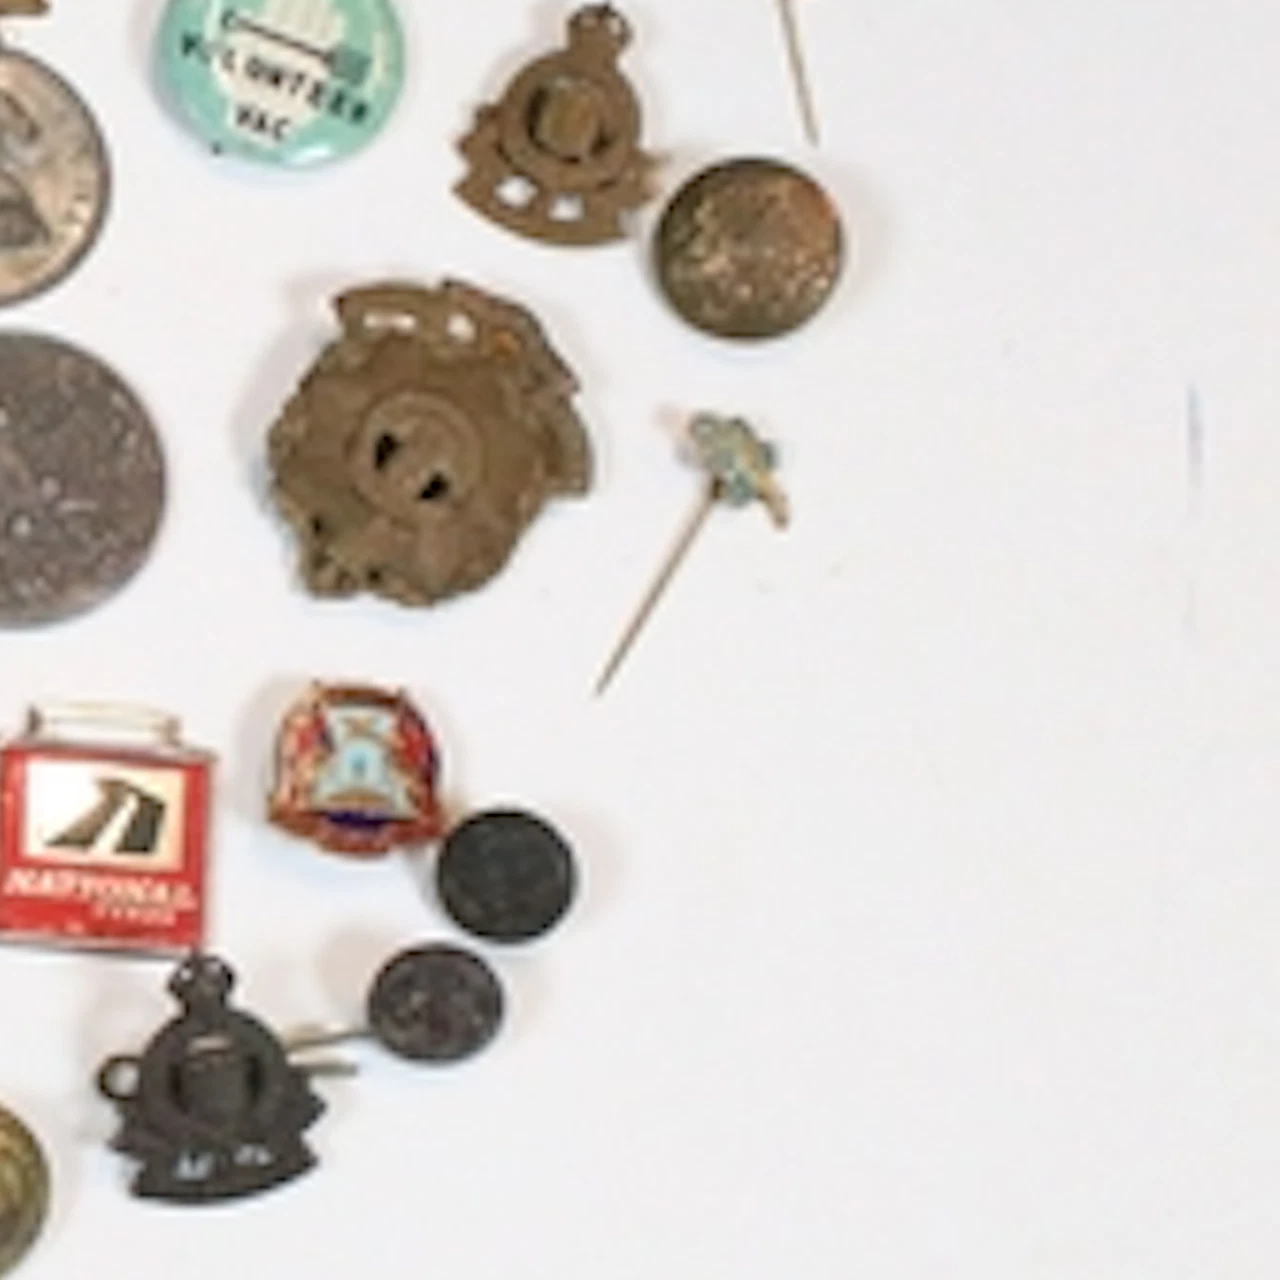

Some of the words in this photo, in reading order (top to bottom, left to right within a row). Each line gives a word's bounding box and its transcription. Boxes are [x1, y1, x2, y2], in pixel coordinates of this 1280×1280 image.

[179, 31, 369, 124] VOLUNTEER
[236, 105, 292, 142] VAC
[2, 868, 198, 910] NATIONAL
